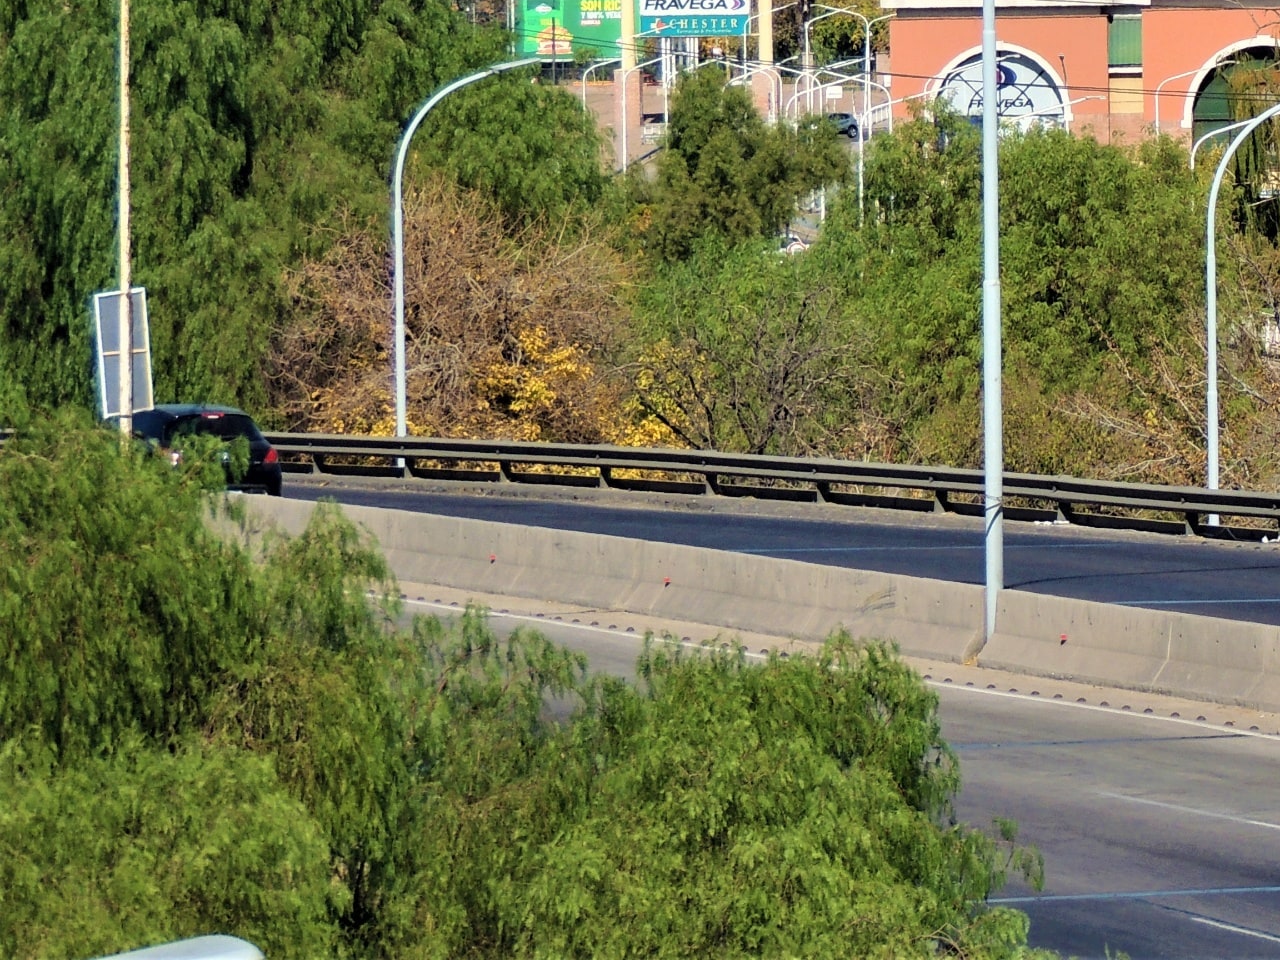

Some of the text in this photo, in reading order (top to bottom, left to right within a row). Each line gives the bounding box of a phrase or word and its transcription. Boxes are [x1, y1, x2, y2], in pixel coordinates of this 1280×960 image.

[604, 0, 621, 11] RIC
[669, 18, 738, 30] CHESTER
[968, 98, 1034, 108] FRVEGA
